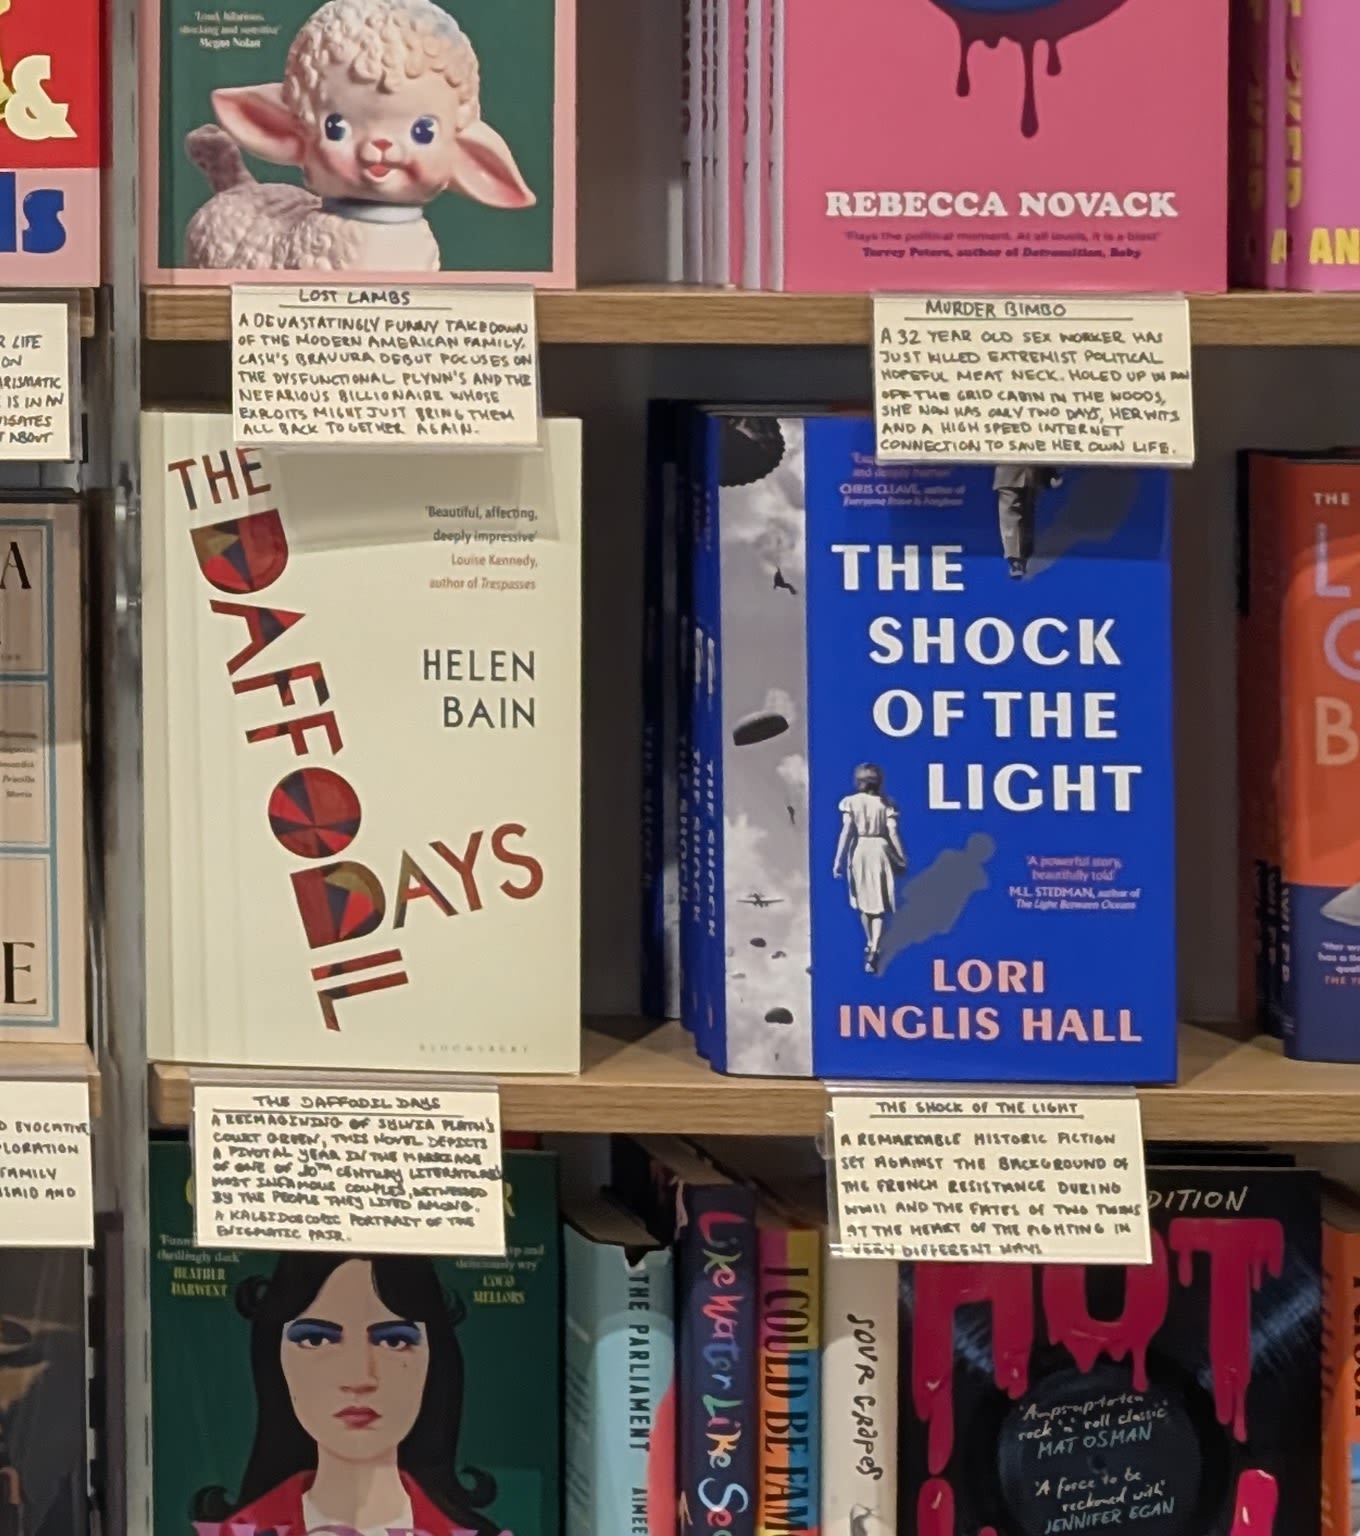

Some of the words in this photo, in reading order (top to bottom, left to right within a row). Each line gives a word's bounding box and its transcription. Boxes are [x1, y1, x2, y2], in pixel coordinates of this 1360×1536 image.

[4, 54, 78, 140] &
[299, 289, 337, 302] LOST
[347, 291, 410, 305] LAMBS
[926, 300, 995, 316] MURDER
[1005, 302, 1066, 316] BIMBO
[486, 505, 538, 521] affecting,
[433, 529, 471, 545] deeply
[452, 554, 484, 566] Louise
[488, 555, 538, 569] Kennedy,
[831, 544, 965, 591] THE
[430, 578, 464, 589] author
[467, 578, 478, 589] of
[481, 578, 535, 591] Trespasses
[868, 617, 1121, 665] SHOCK
[423, 651, 535, 682] HELEN
[444, 697, 535, 729] BAIN
[872, 690, 965, 737] OF
[983, 692, 1117, 738] THE
[928, 764, 1142, 811] LIGHT
[933, 959, 1044, 992] LORI
[840, 1005, 1000, 1040] INGLIS
[1023, 1008, 1141, 1041] HALL
